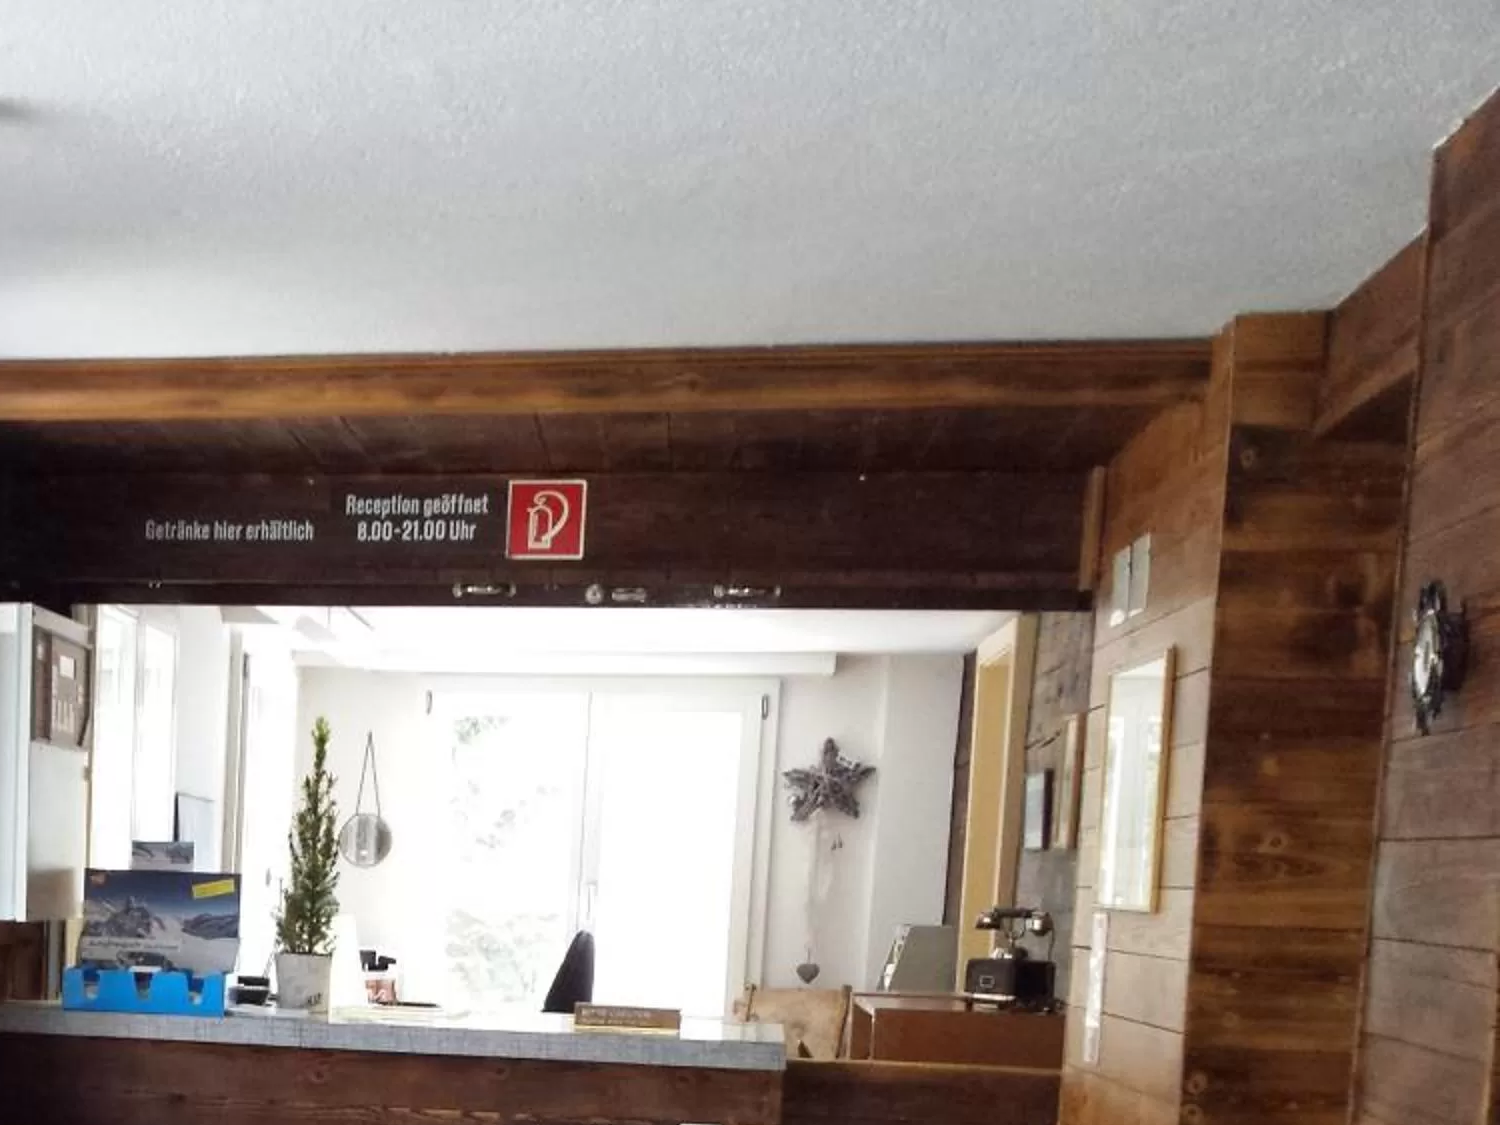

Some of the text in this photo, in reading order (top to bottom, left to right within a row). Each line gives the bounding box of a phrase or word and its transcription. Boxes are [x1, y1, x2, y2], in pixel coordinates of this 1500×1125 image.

[345, 493, 489, 518] Reception geöffnet
[145, 519, 315, 541] Getränke hier erhältlich
[449, 520, 477, 541] Uhr
